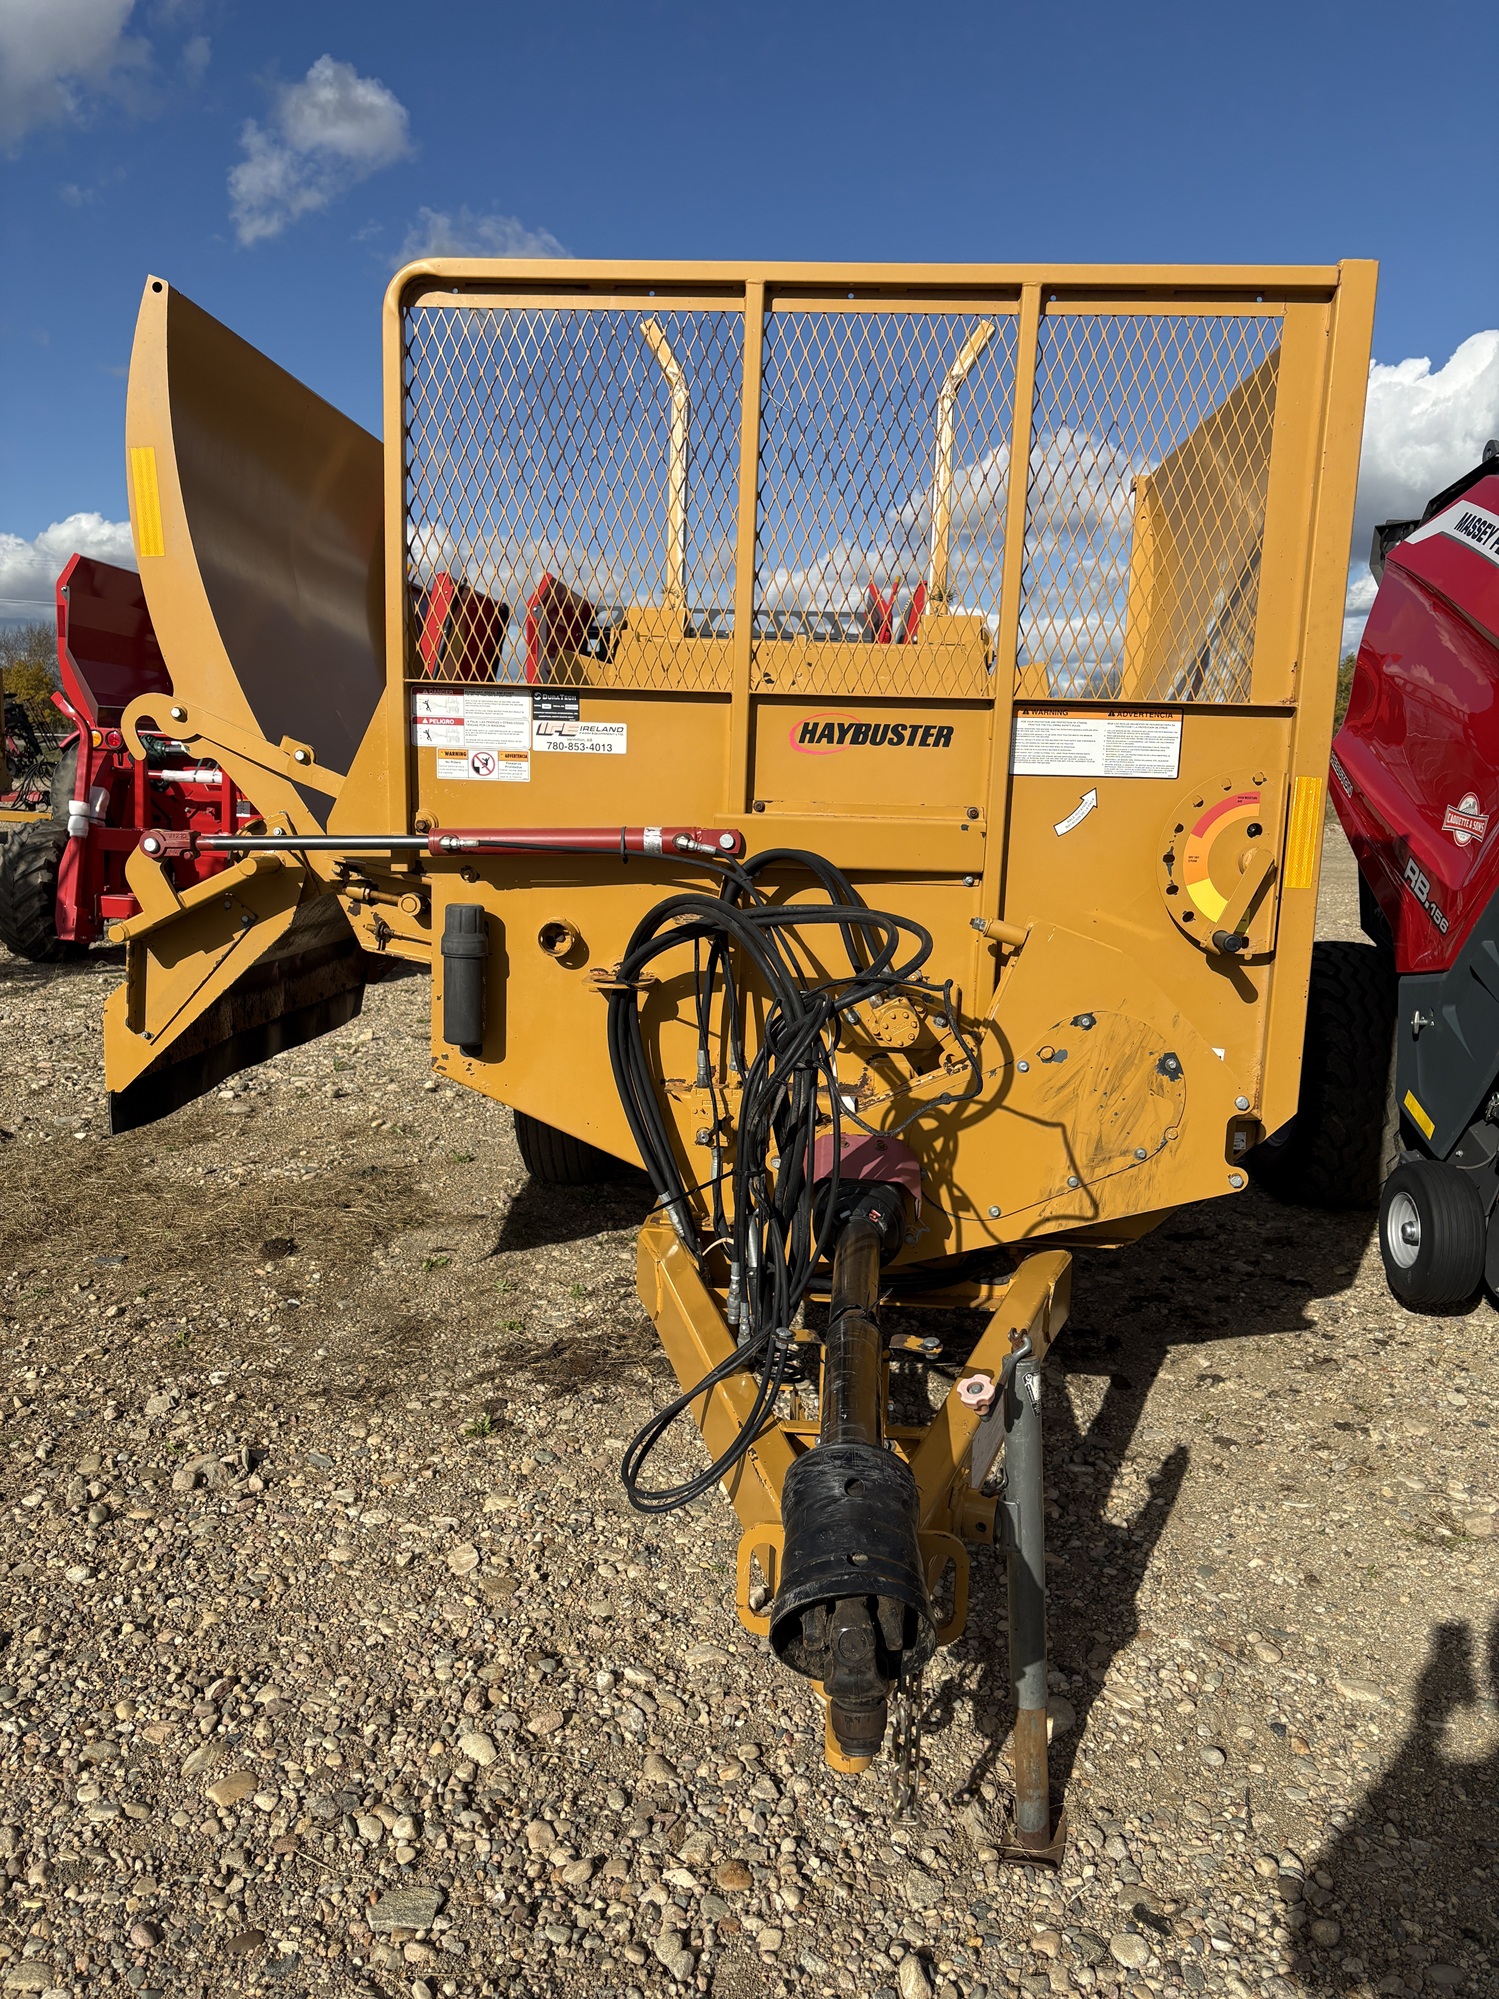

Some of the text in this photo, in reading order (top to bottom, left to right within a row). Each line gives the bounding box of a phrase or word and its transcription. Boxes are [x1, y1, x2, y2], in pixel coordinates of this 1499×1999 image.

[1454, 511, 1499, 546] MASSEY
[1117, 710, 1173, 718] ADVERTENCIA
[580, 725, 624, 733] IRELAND
[798, 722, 955, 748] HAYBUSTER
[546, 741, 613, 752] 780-853-4013
[1472, 821, 1485, 833] SONS
